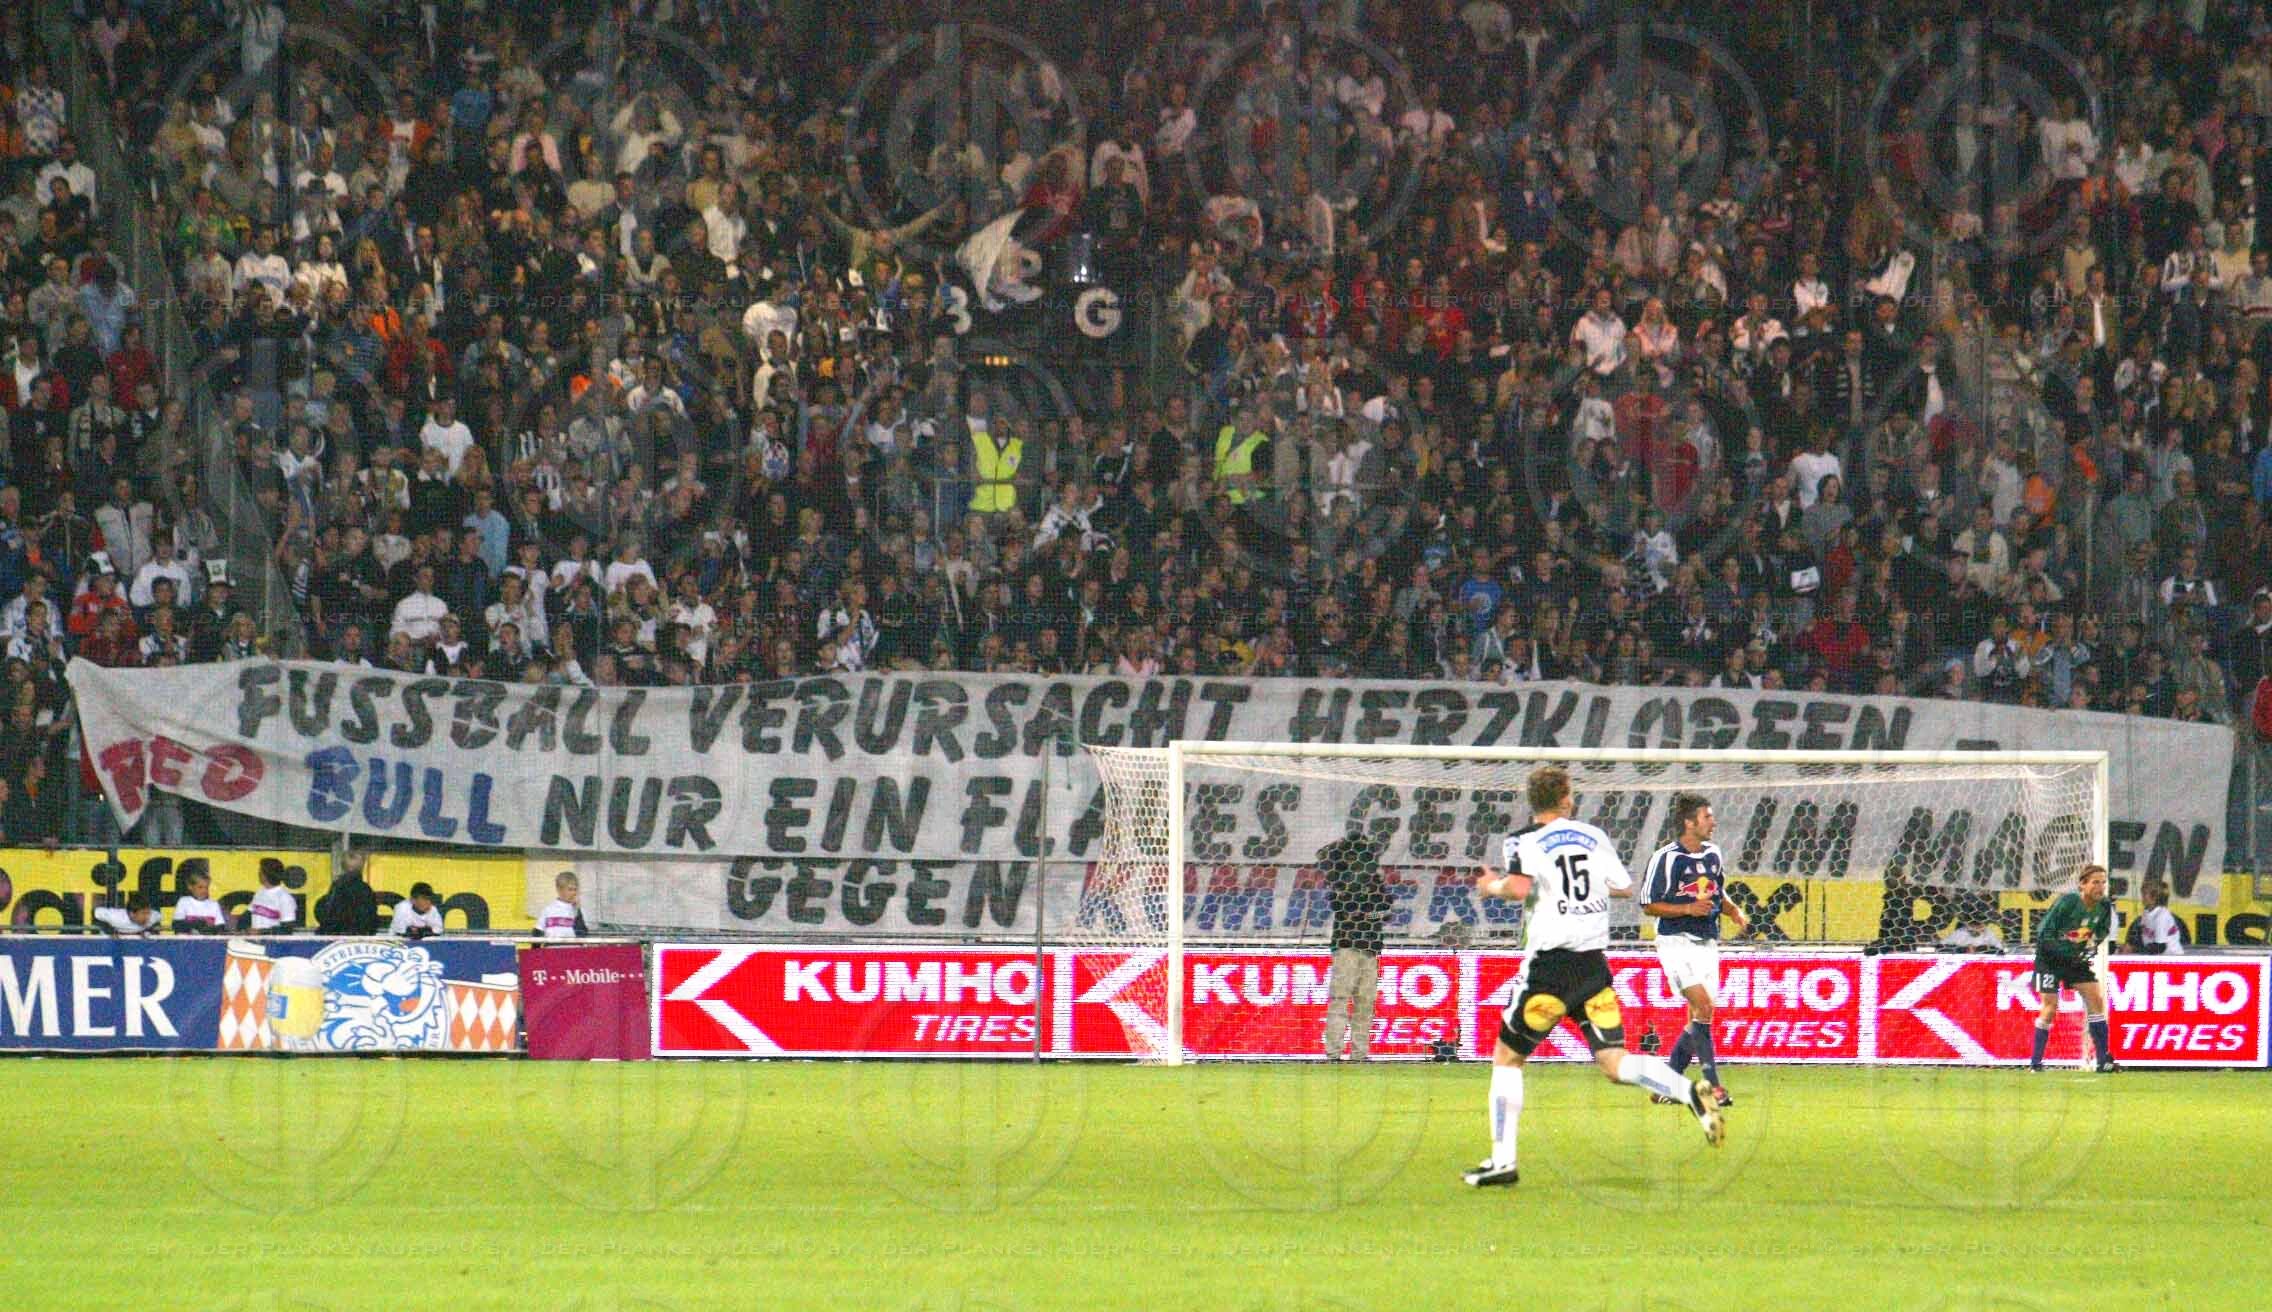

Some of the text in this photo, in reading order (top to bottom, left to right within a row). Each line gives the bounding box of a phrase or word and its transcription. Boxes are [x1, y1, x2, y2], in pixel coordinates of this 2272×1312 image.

[238, 666, 651, 755] FUSSBALL
[689, 678, 1251, 762] VERURSACHT
[101, 734, 264, 814] RED
[305, 745, 505, 844] BULL
[540, 775, 721, 850] NUR
[765, 776, 931, 852] EIN
[1737, 797, 1858, 877] IM
[727, 857, 1030, 928] GEGEN
[1555, 854, 1590, 901] 15
[783, 961, 1043, 1005] KUMHO
[2042, 973, 2055, 988] 22
[912, 1016, 1037, 1042] TIRES
[1320, 1017, 1447, 1044] RES
[1721, 1020, 1847, 1048] TIRES
[2121, 1024, 2247, 1051] TIRES
